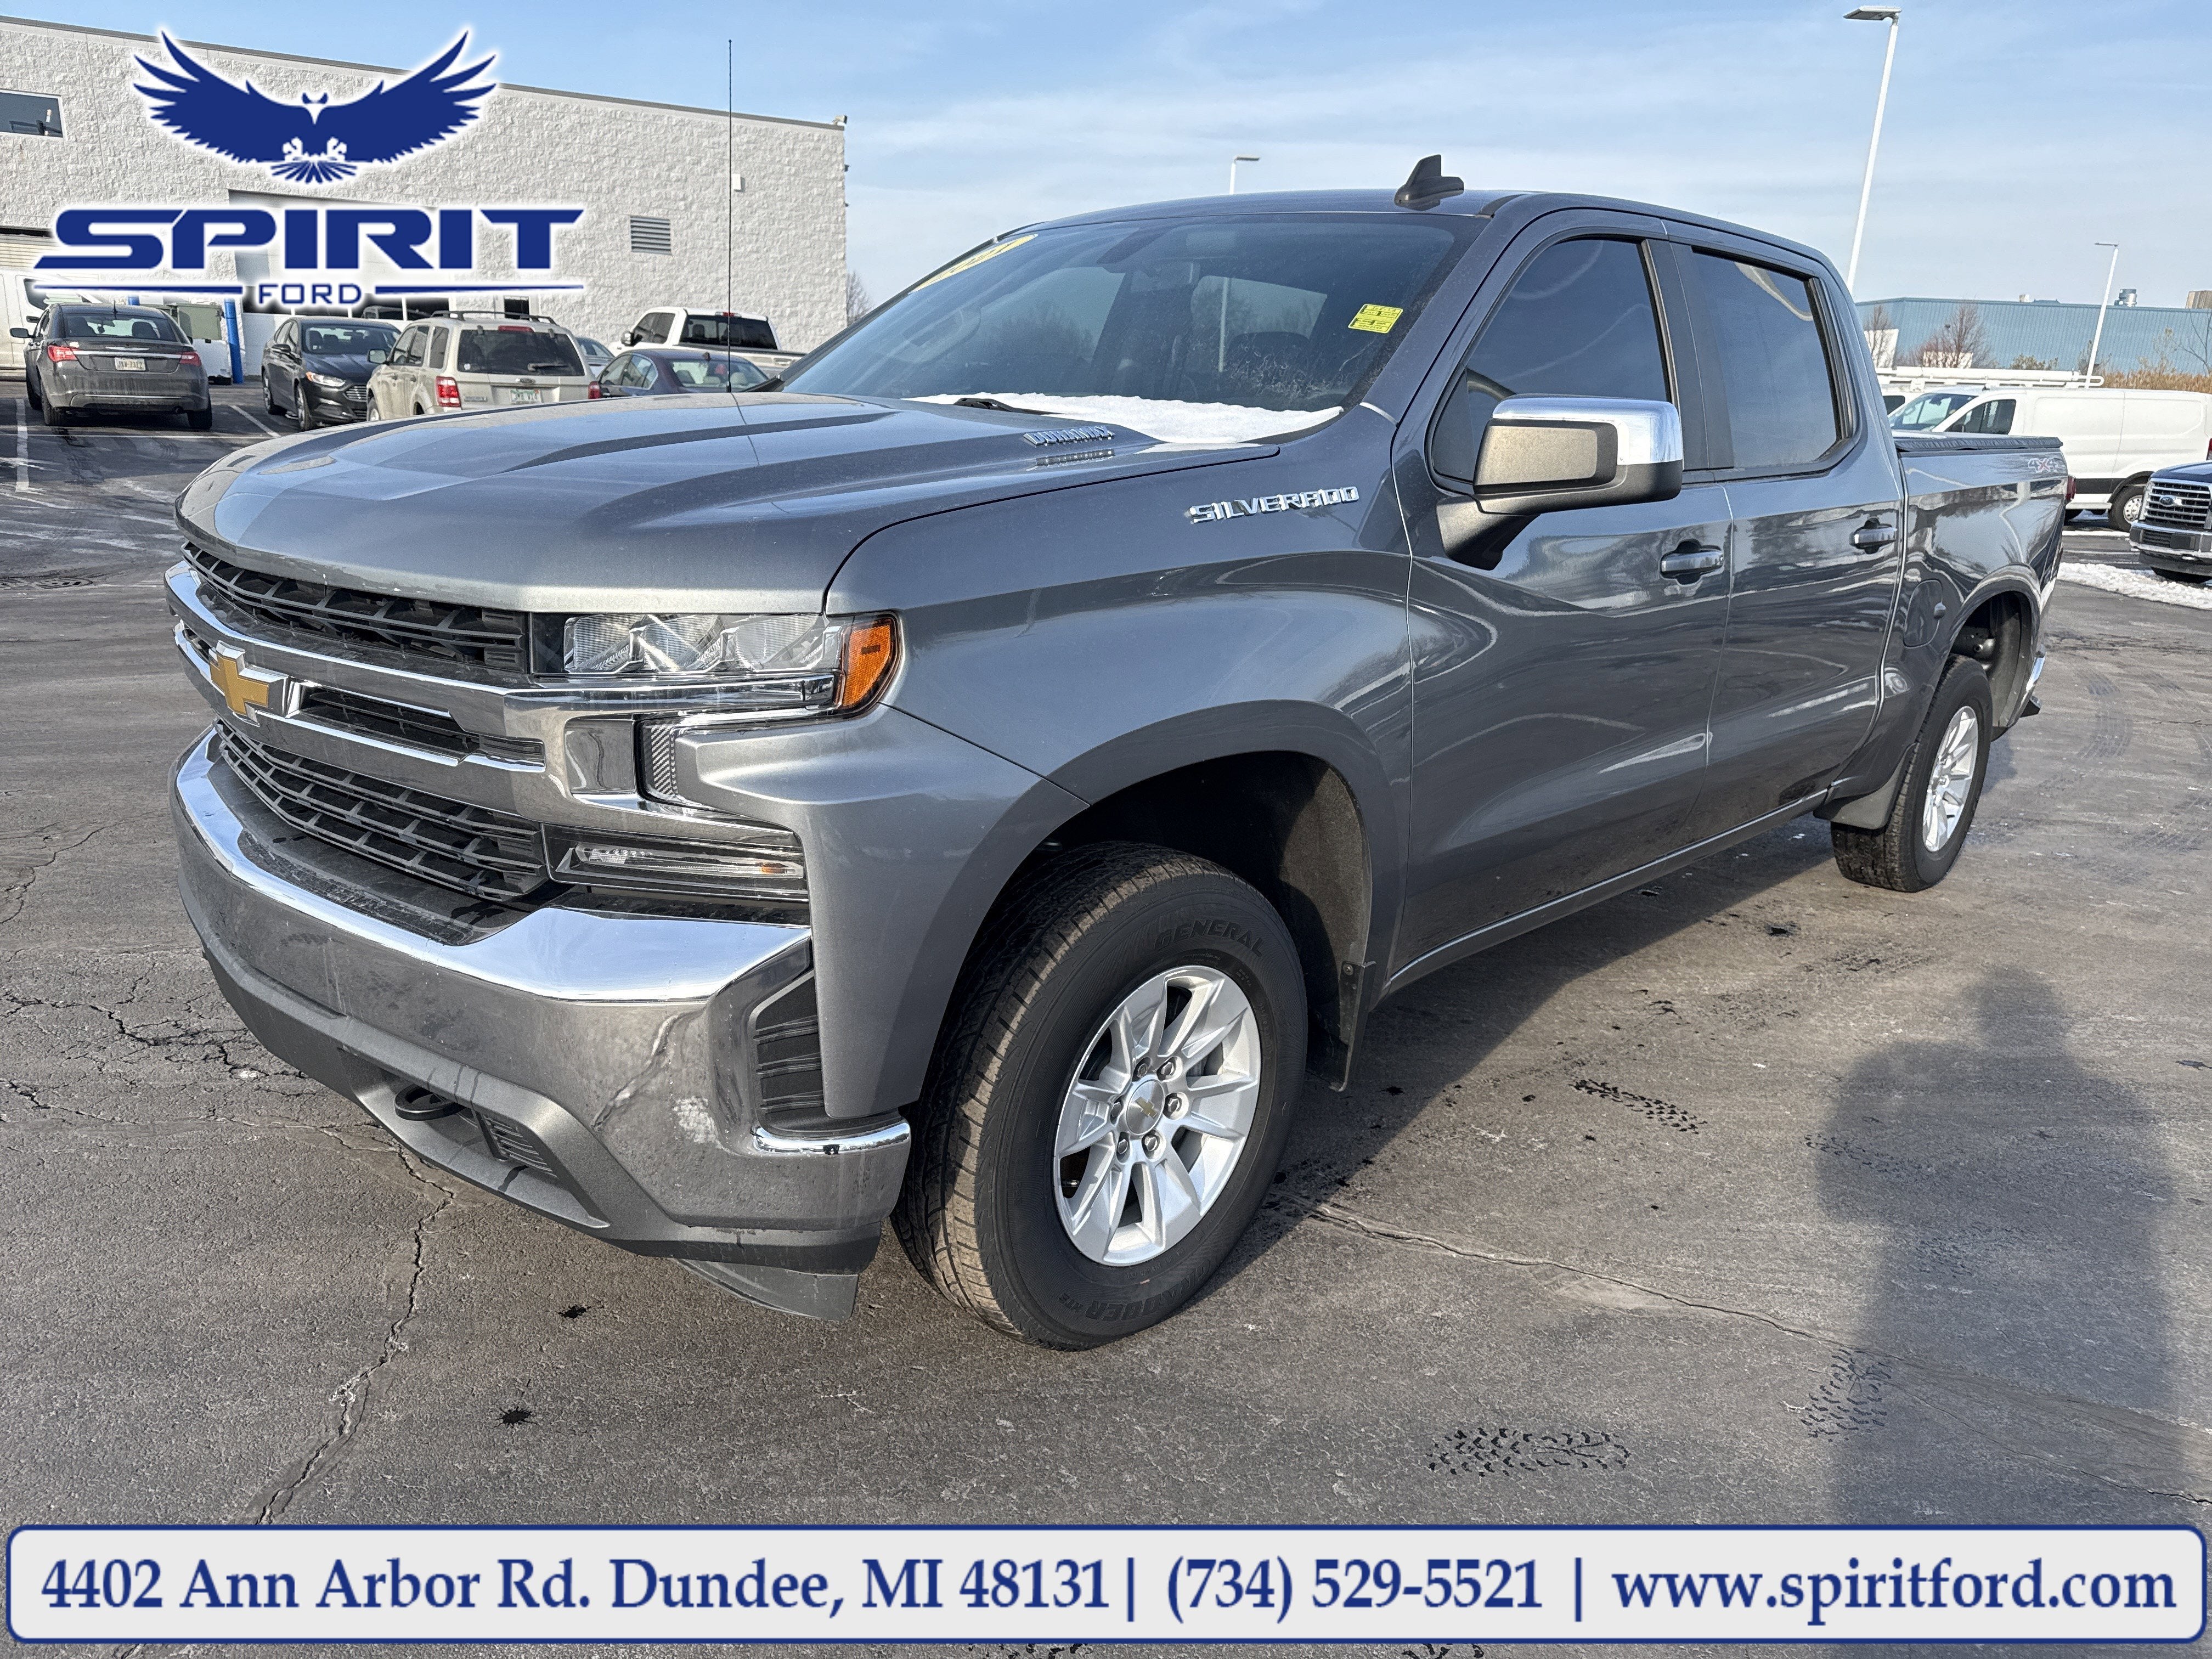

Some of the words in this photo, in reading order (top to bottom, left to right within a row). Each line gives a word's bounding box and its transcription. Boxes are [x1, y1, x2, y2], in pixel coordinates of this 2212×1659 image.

[1024, 425, 1116, 446] DURAMAX
[1189, 486, 1359, 524] SILVERADO
[1153, 919, 1264, 957] GENERAL
